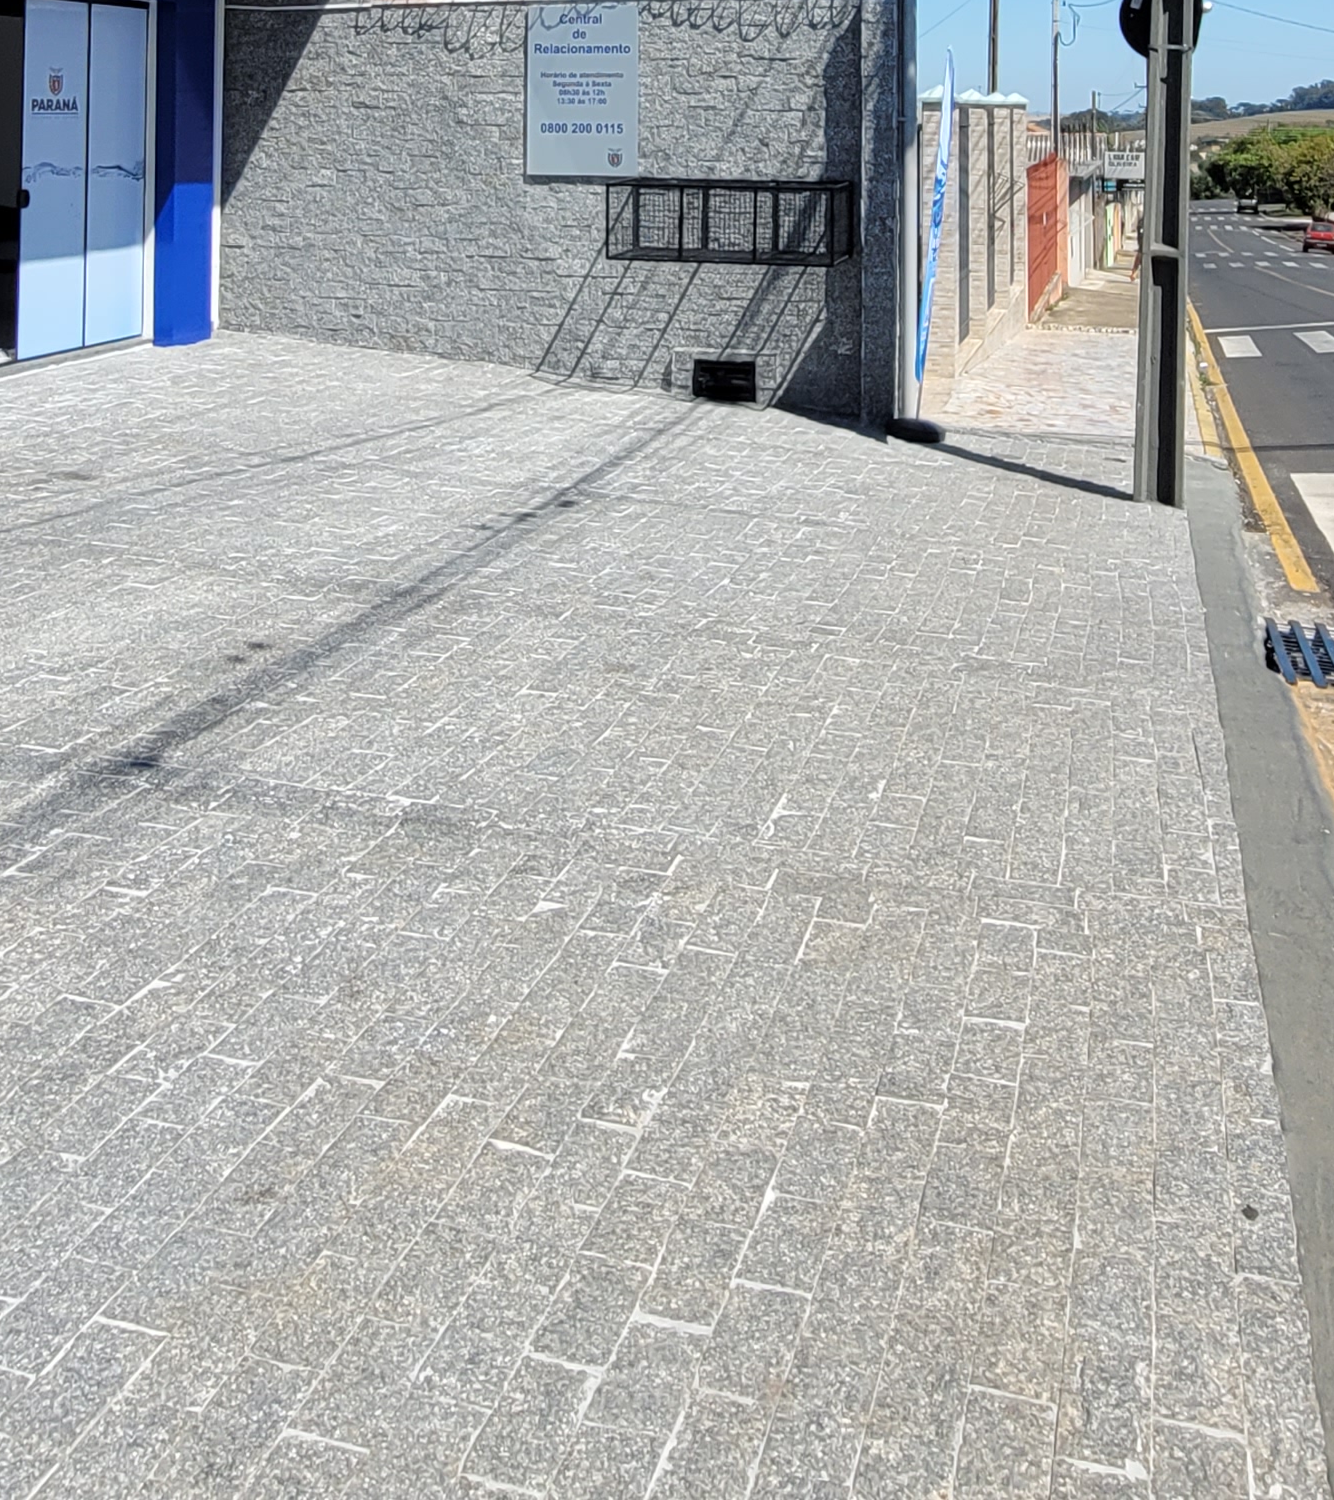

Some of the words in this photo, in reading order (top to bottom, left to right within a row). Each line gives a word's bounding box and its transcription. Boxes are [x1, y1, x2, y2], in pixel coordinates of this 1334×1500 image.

[559, 13, 602, 24] Central
[572, 29, 587, 39] de
[534, 43, 631, 54] Relacionamento
[31, 96, 79, 111] PARANÁ
[541, 122, 568, 134] 0800
[571, 122, 593, 134] 200
[596, 122, 624, 134] 0115
